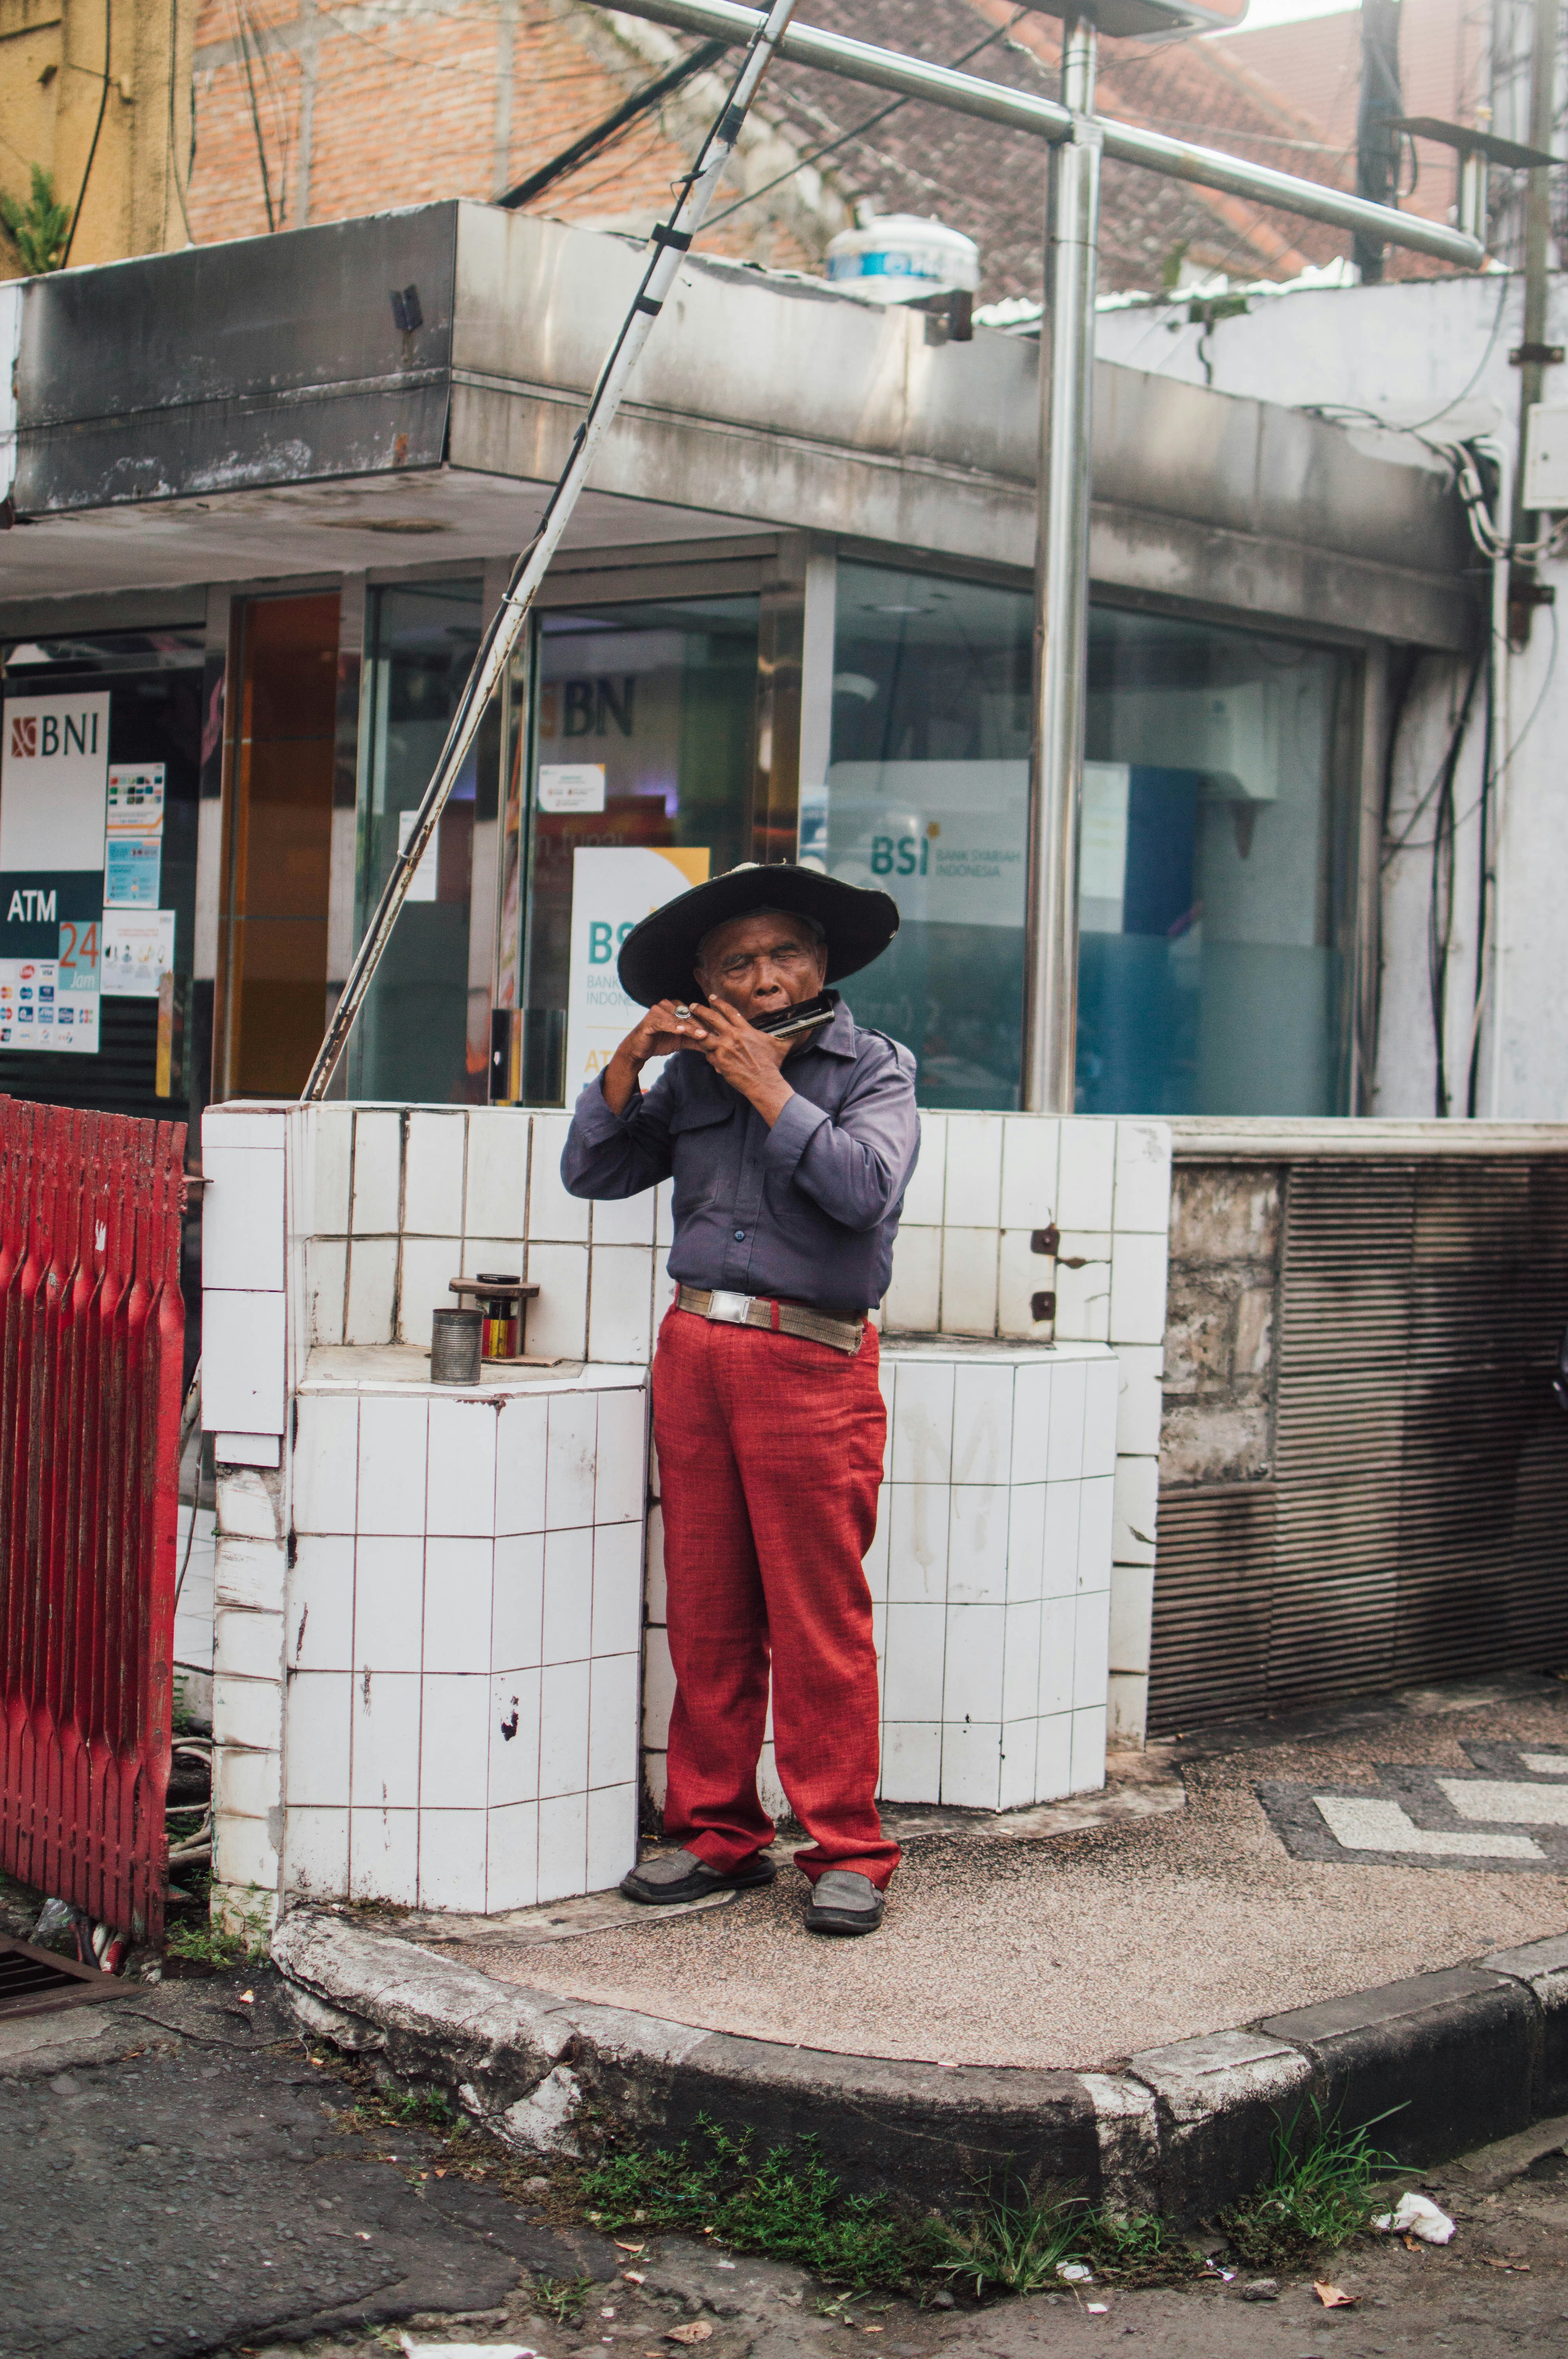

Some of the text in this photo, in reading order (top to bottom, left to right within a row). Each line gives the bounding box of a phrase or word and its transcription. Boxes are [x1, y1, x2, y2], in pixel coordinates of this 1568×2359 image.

[41, 712, 99, 756] BNI
[871, 836, 929, 876] BSI
[7, 889, 57, 922] ATM
[59, 921, 99, 969] 24
[71, 971, 95, 989] Jam
[587, 974, 620, 989] BANK
